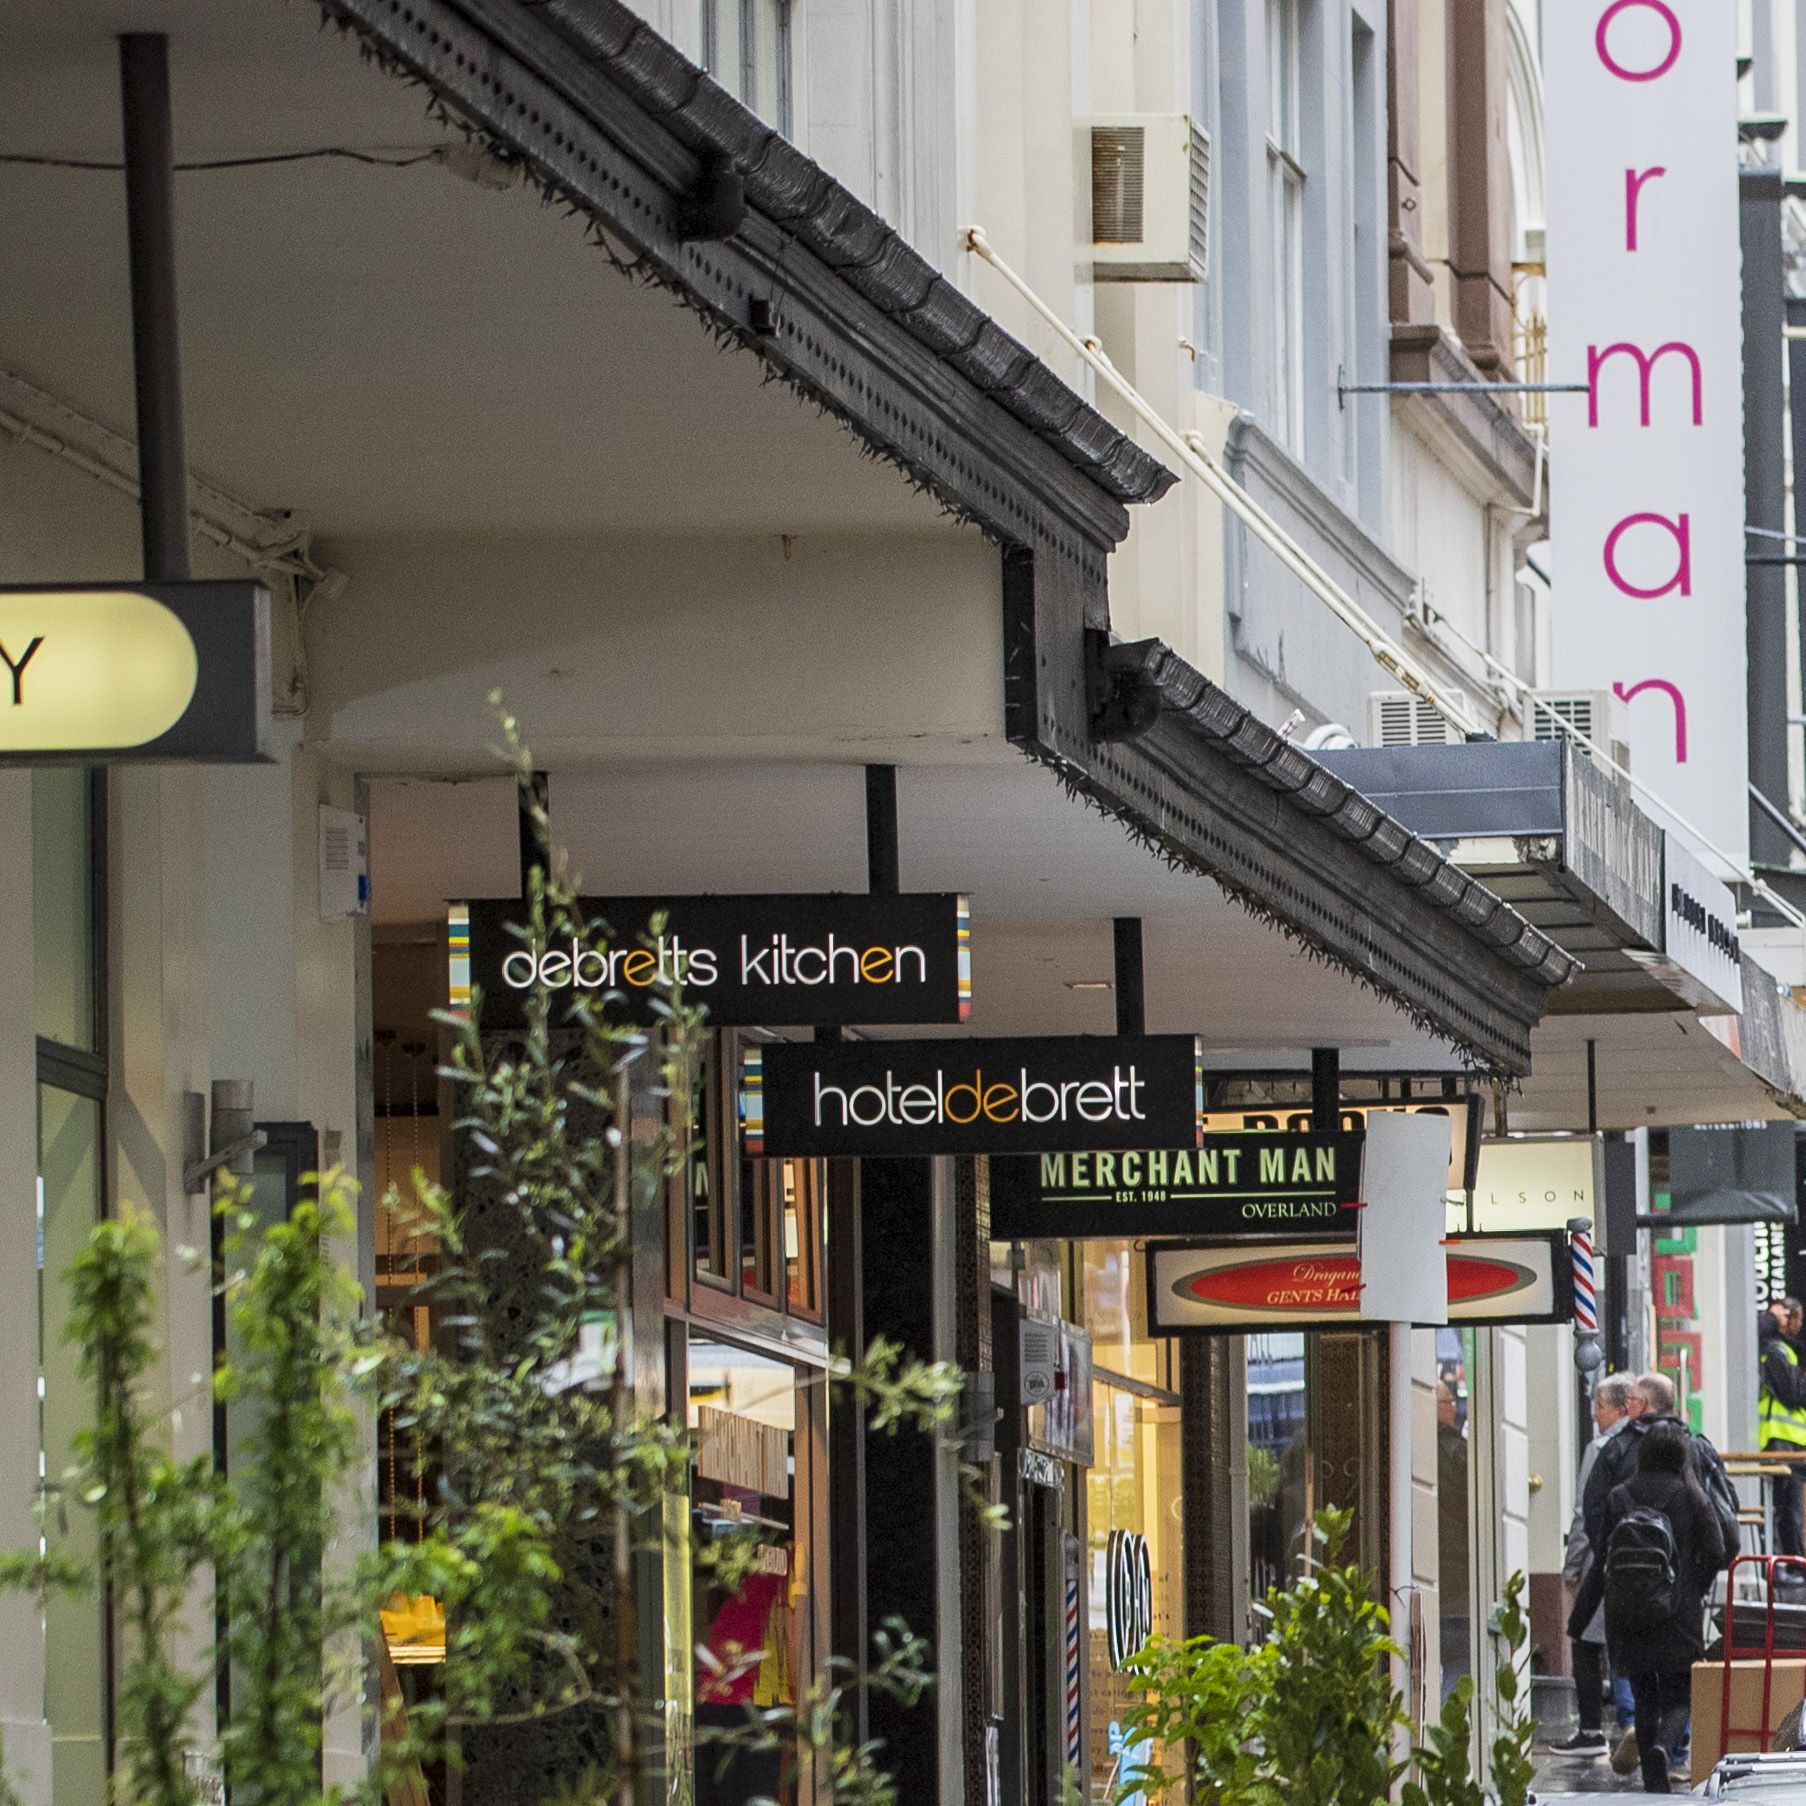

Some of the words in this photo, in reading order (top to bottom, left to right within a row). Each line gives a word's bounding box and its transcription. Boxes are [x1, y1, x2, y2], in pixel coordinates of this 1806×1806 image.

[502, 935, 718, 988] debretts
[741, 933, 927, 985] kitchen
[814, 1066, 1146, 1129] hoteldebrett
[1041, 1149, 1241, 1188] MERCHANT
[1260, 1146, 1336, 1183] MAN
[1241, 1201, 1337, 1219] OVERLAND
[1463, 1190, 1584, 1205] LSON
[1266, 1289, 1322, 1305] GENTS
